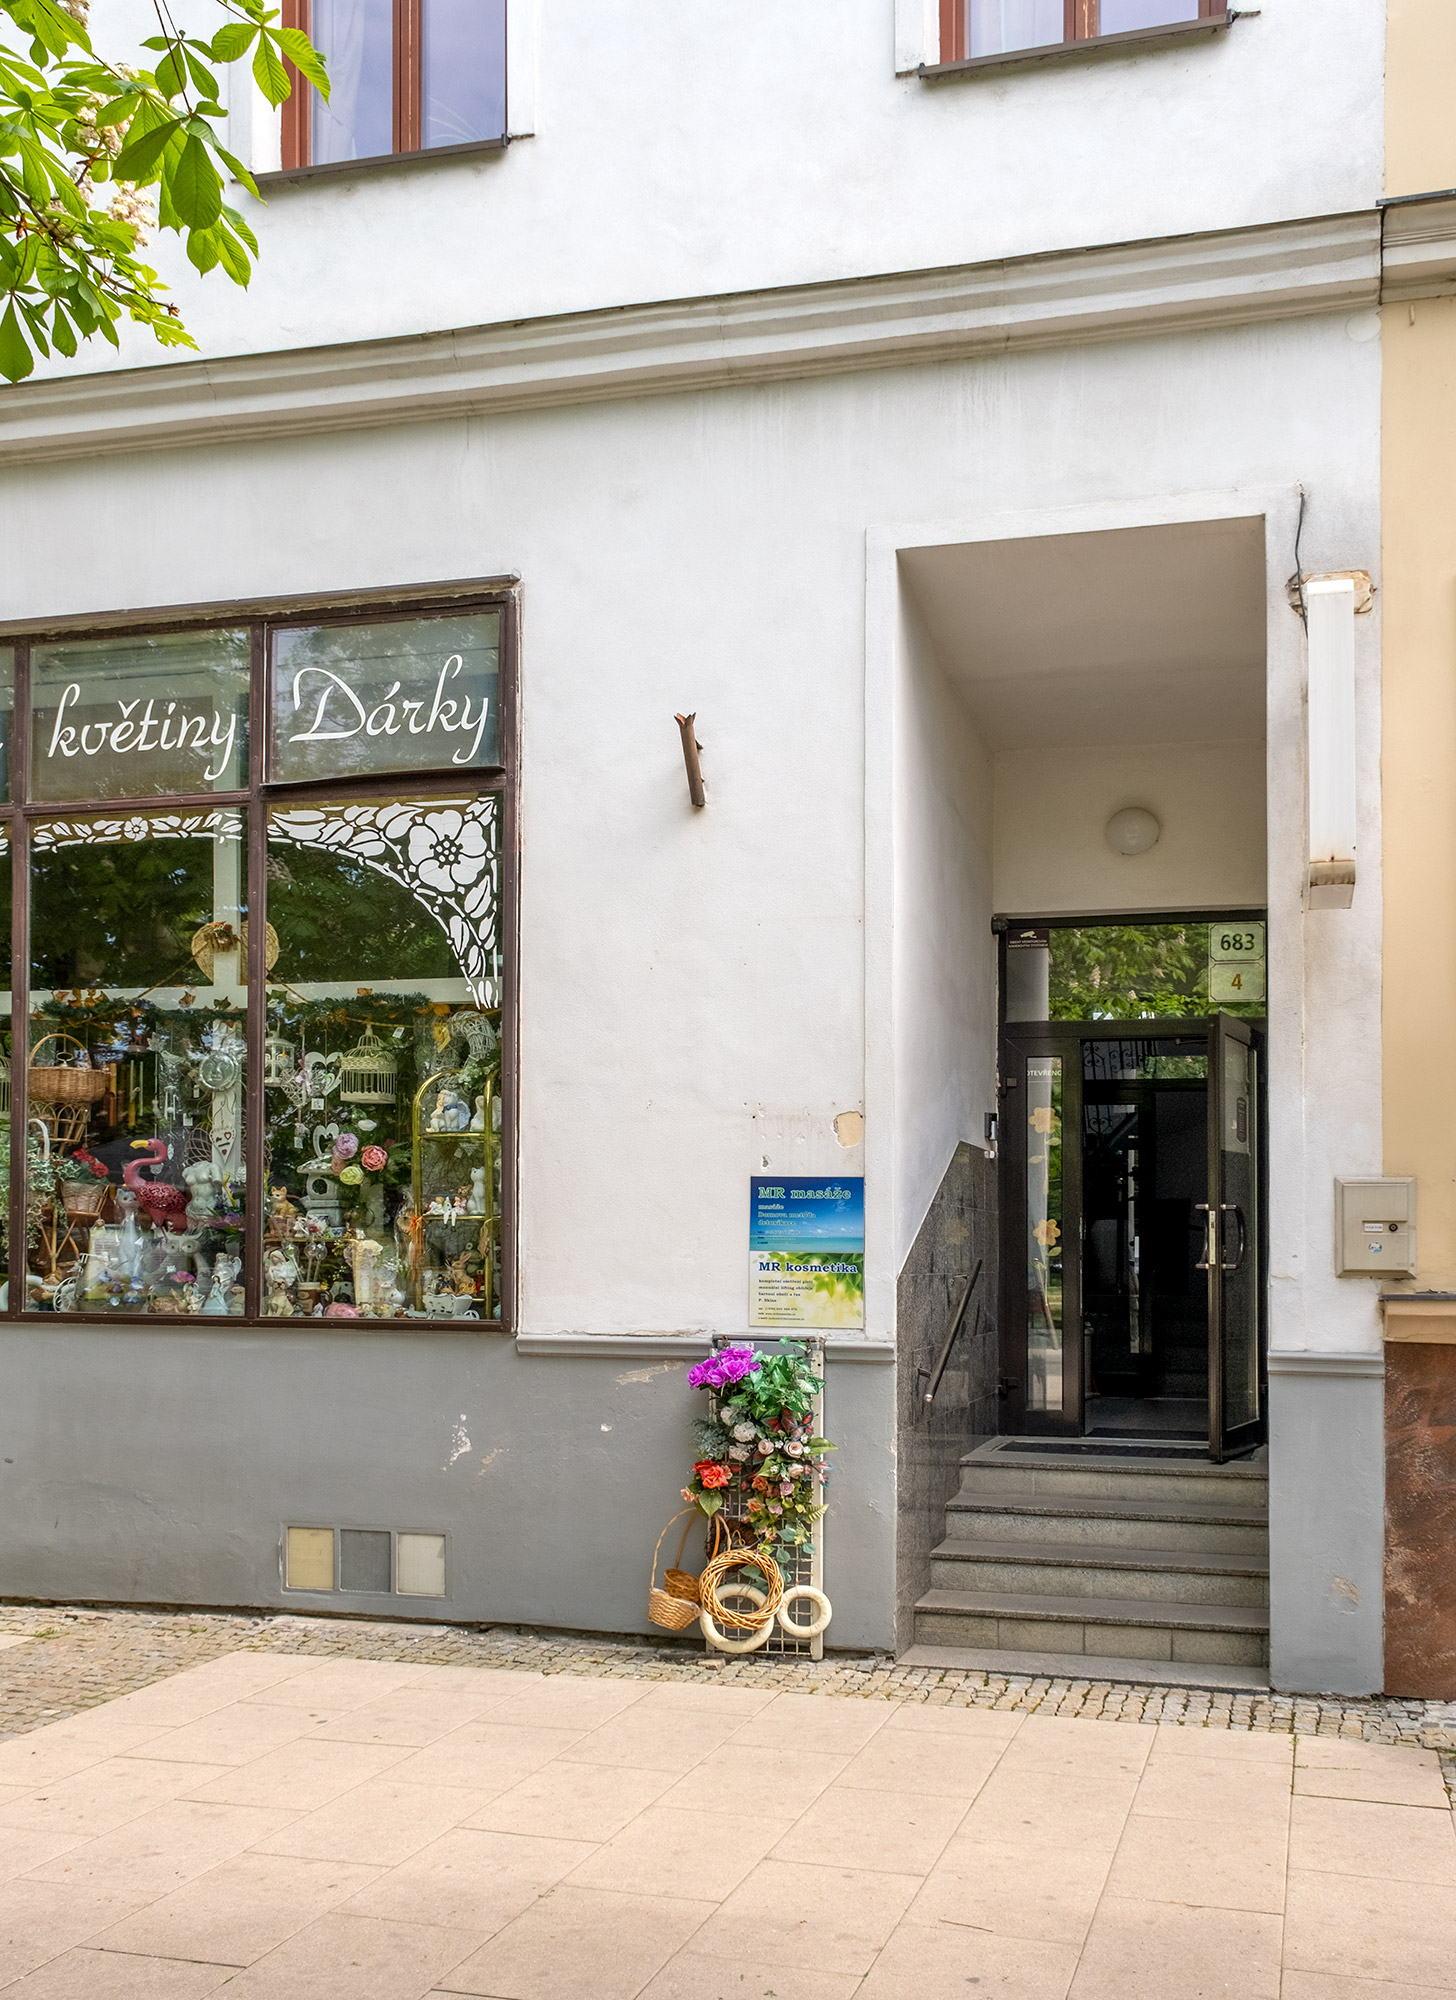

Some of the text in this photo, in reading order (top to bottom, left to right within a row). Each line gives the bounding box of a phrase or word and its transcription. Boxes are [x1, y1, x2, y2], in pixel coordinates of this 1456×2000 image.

[48, 654, 489, 781] květiny Dárky
[1221, 933, 1255, 951] 683
[1231, 973, 1243, 990] 4
[758, 1186, 851, 1199] MR masáže
[758, 1262, 858, 1274] MR kosmetika
